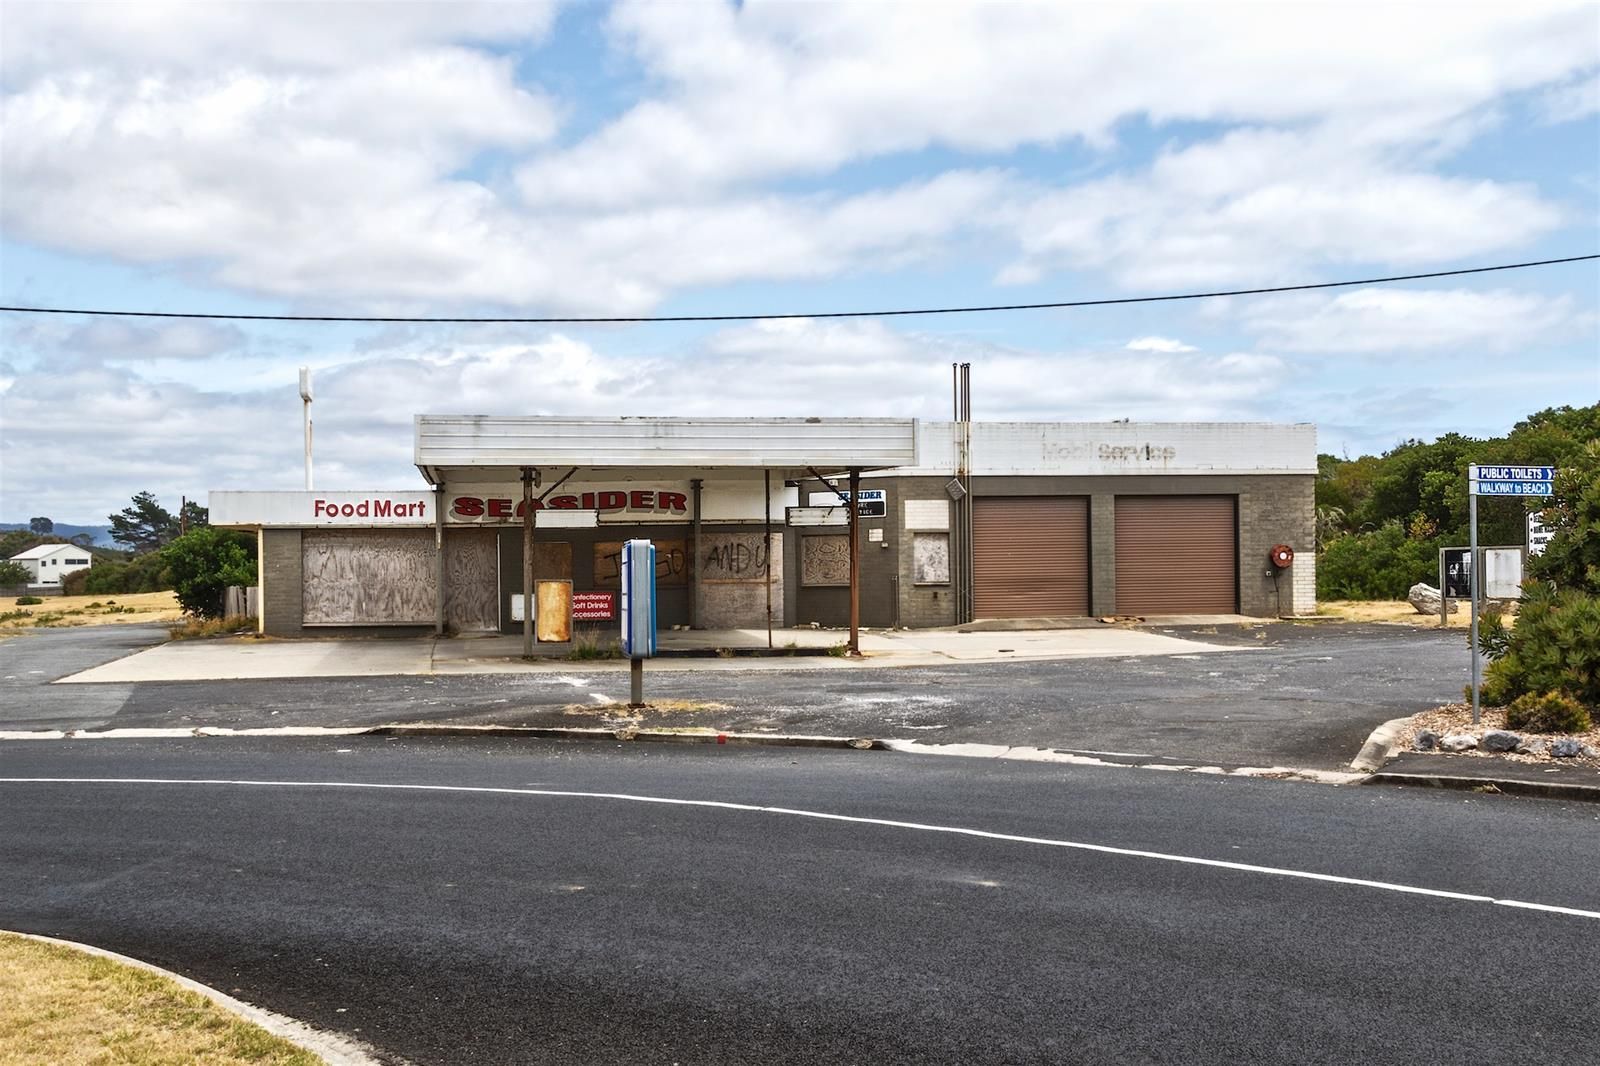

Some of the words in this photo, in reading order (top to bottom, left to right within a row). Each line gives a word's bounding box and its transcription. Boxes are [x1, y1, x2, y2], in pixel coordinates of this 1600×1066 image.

[1098, 442, 1176, 461] Service
[1481, 468, 1509, 479] PUBLIC
[1511, 468, 1542, 479] TOILETS
[1480, 483, 1513, 493] WALKWAY
[1515, 483, 1521, 493] to
[1522, 483, 1546, 493] BEACH
[314, 500, 369, 517] Food
[374, 500, 426, 517] Mart
